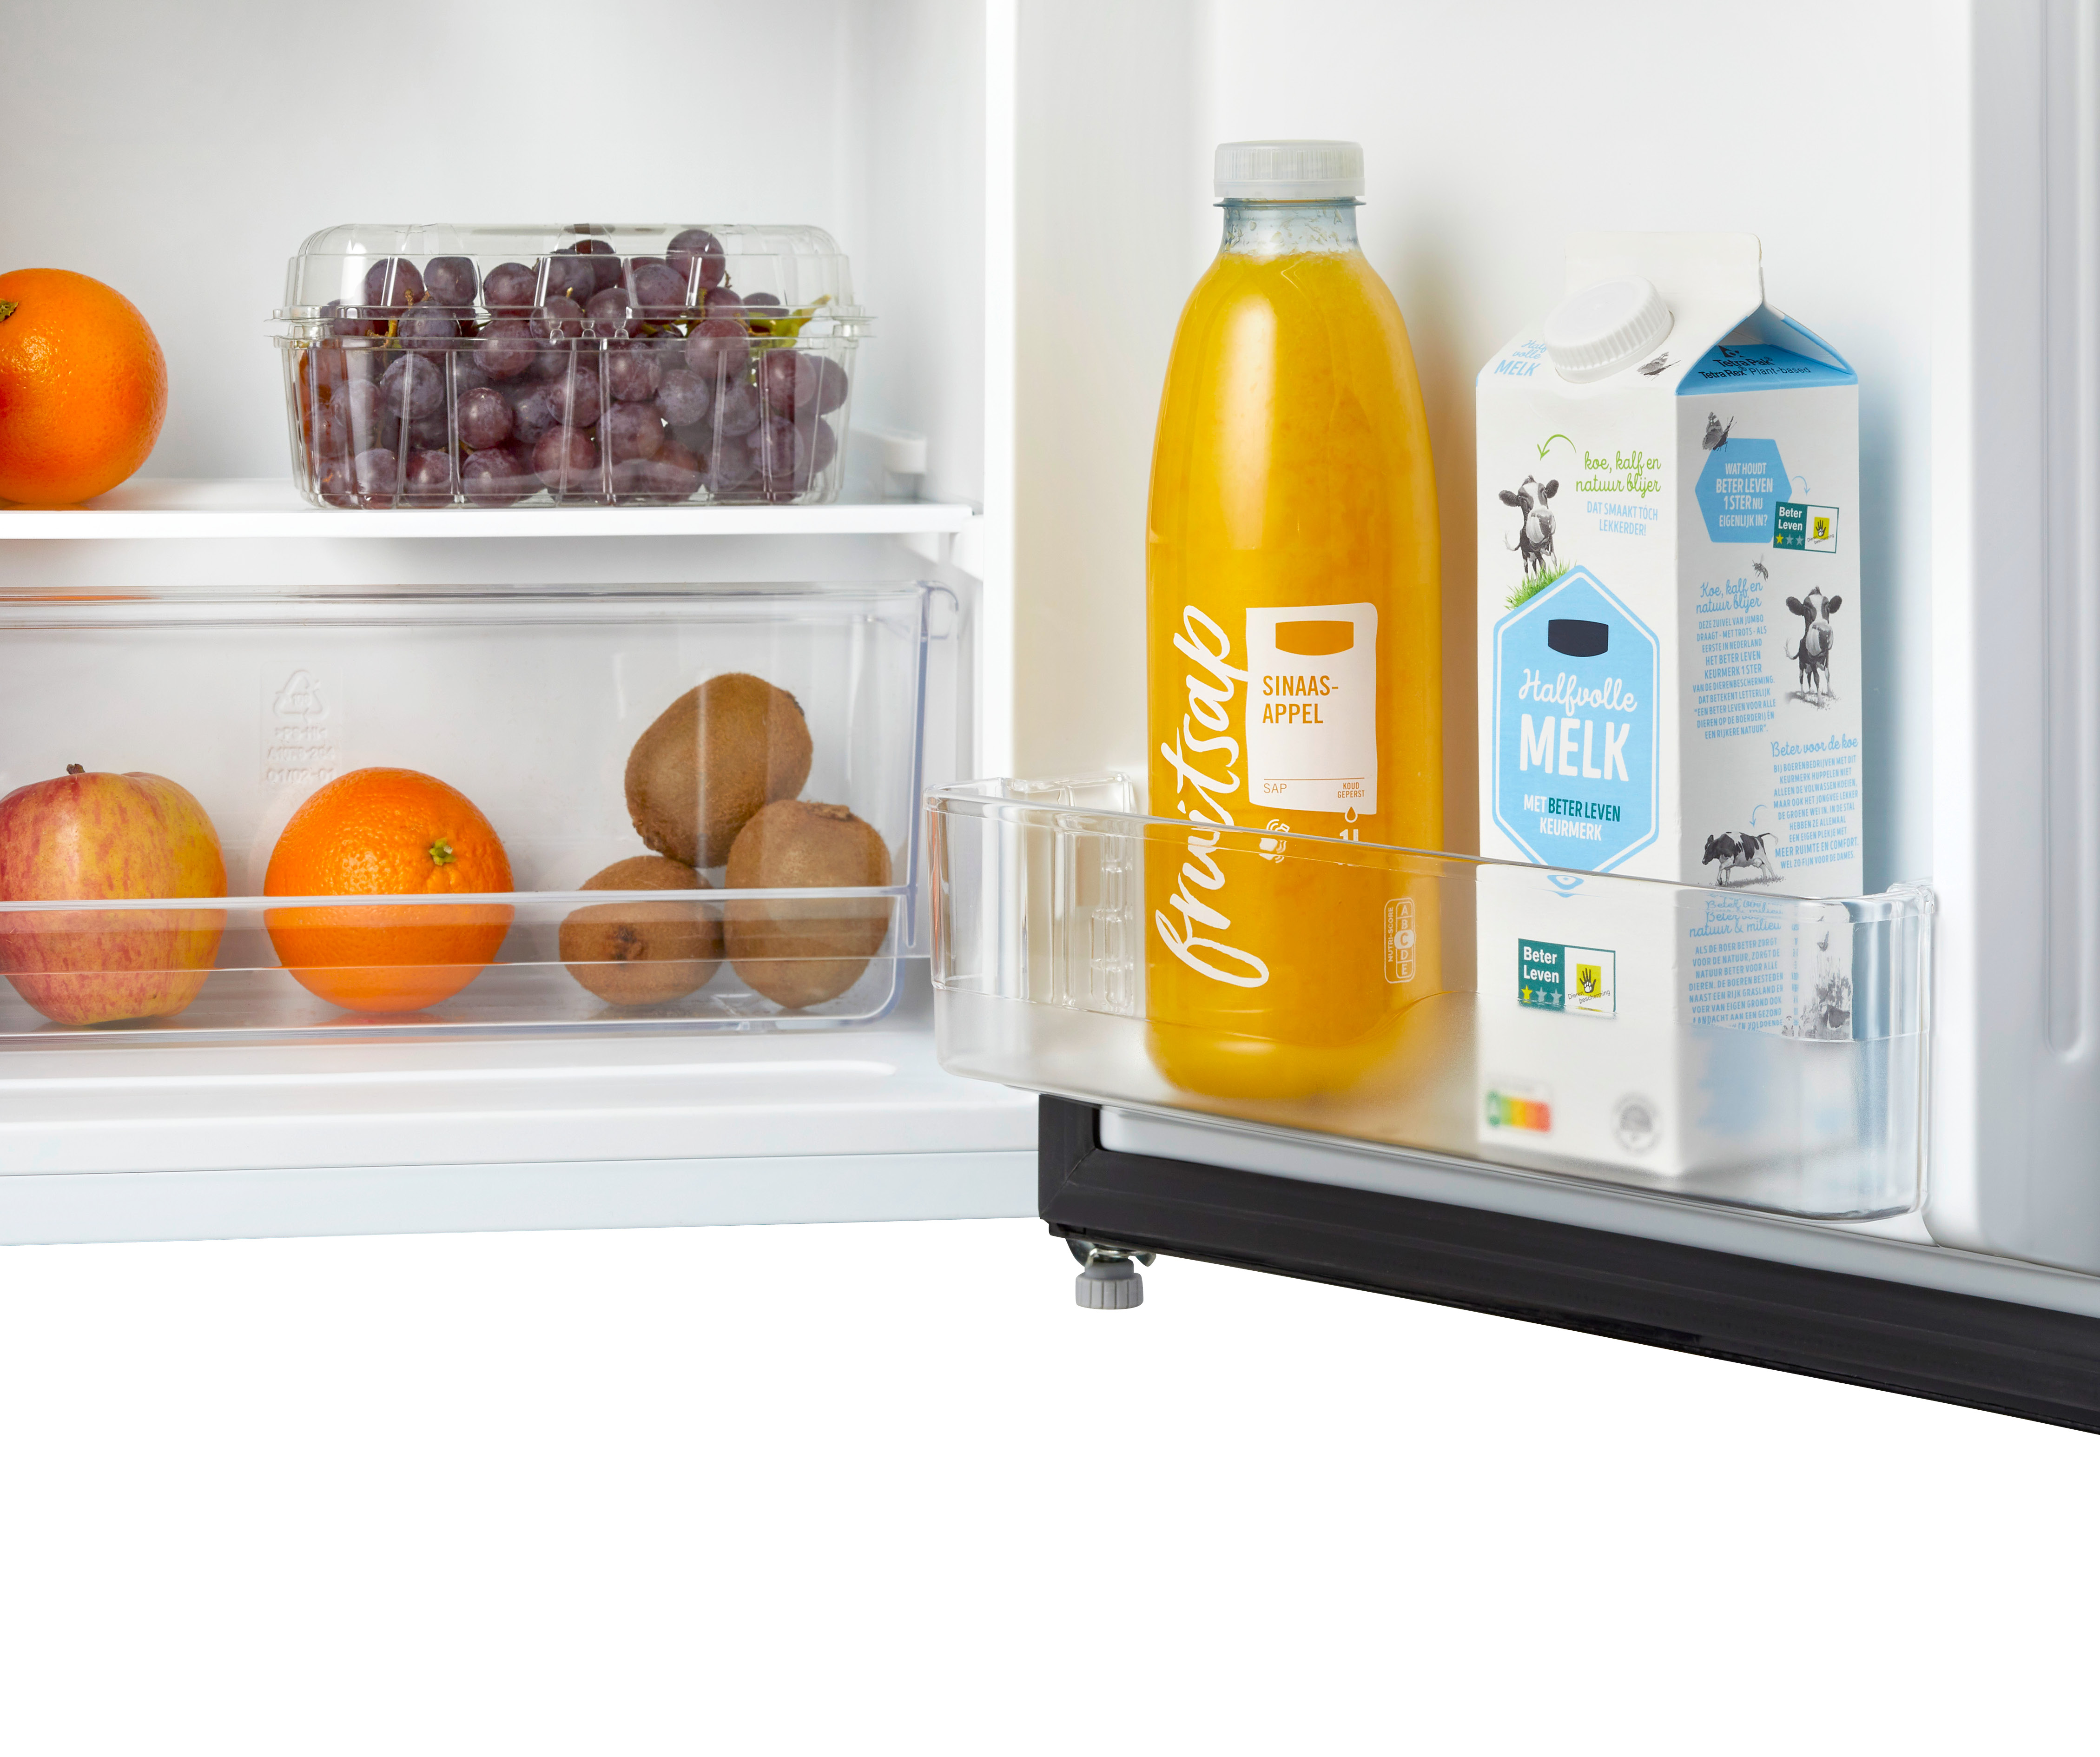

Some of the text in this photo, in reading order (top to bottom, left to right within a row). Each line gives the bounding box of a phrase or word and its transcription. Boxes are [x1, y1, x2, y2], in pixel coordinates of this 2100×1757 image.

[1512, 350, 1541, 359] volle
[1494, 360, 1541, 376] MELK
[1585, 451, 1661, 476] koe, kalf en
[1725, 463, 1766, 475] WAT HOUDT
[1576, 473, 1661, 498] natuur blijer
[1716, 478, 1773, 493] BETER LEVEN
[1724, 495, 1763, 509] 1 STER NU
[1587, 501, 1658, 521] DAT SMAAKT TÓCH
[1779, 507, 1802, 518] Beter
[1599, 519, 1646, 536] LEKKERDER!
[1719, 515, 1768, 528] EIGENLIJK IN?
[1778, 519, 1803, 531] Leven
[1700, 578, 1763, 598] Koe, kalf en
[1697, 594, 1762, 614] natuur blijer
[1699, 614, 1763, 629] DEZE ZUIVEL VAN JUMBO
[1697, 626, 1767, 641] DRAAGT MET TROTS ALS
[1702, 643, 1721, 653] EERSTE
[1730, 639, 1762, 649] NEDERLAND
[1706, 651, 1761, 666] HET BETER LEVEN
[1705, 664, 1762, 679] KEURMERK 1 STER
[1262, 675, 1339, 696] SINAAS-
[1519, 668, 1637, 716] Halfvolle
[1693, 676, 1775, 693] VAN DE DIERENBESCHERMING.
[1699, 688, 1770, 704] DAT BETEKENT LETTERLIJK
[1262, 703, 1323, 724] APPEL
[1710, 705, 1727, 714] BETER
[1728, 703, 1745, 712] LEVEN
[1746, 701, 1762, 710] VOOR
[1763, 699, 1776, 708] ALLE
[1697, 718, 1717, 728] DIEREN
[1719, 717, 1726, 726] OP
[1728, 716, 1734, 725] DE
[1736, 713, 1766, 723] BOERDERIJ
[1705, 731, 1715, 739] EEN
[1717, 727, 1739, 738] RIJKERE
[1519, 713, 1630, 782] MELK
[1771, 733, 1858, 757] Beter voor de koe
[1774, 765, 1782, 773] BIJ
[1784, 758, 1835, 772] BOERENBEDRIJVEN
[1836, 756, 1847, 765] MET
[1780, 767, 1851, 784] KEURMERK HUPPELEN NIET
[1264, 783, 1287, 793] SAP
[1774, 787, 1795, 797] ALLEEN
[1796, 786, 1803, 794] DE
[1804, 782, 1836, 793] VOLWASSEN
[1774, 790, 1858, 808] MAAR OOK HET JONGVEE LEKKER
[1524, 794, 1620, 822] MET BETER LEVEN
[1787, 809, 1808, 819] GROENE
[1810, 807, 1820, 816] WEI
[1844, 802, 1855, 811] STAL
[1540, 817, 1602, 841] KEURMERK
[1790, 816, 1846, 830] HEBBEN ZE ALLEMAAL
[1790, 827, 1847, 842] EEN EIGEN PLEKJE MET
[1775, 837, 1859, 858] MEER RUIMTE EN COMFORT.
[1781, 860, 1792, 869] WEL
[1794, 859, 1801, 867] ZO
[1802, 858, 1813, 866] FIJN
[1815, 855, 1829, 864] VOOR
[1837, 851, 1855, 860] DAMES.
[1401, 905, 1408, 916] A
[1401, 919, 1408, 929] B
[1690, 919, 1781, 938] natuur & milieu
[1400, 932, 1408, 946] C
[1695, 945, 1707, 954] ALS
[1719, 943, 1735, 951] BOER
[1737, 940, 1756, 950] BETER
[1758, 938, 1777, 946] ZORGT
[1401, 950, 1408, 960] D
[1524, 946, 1557, 964] Beter
[1693, 958, 1711, 967] VOOR
[1713, 956, 1721, 965] DE
[1723, 953, 1750, 964] NATUUR,
[1752, 949, 1771, 959] ZORGT
[1401, 964, 1407, 975] E
[1524, 965, 1559, 983] Leven
[1579, 990, 1610, 1004] bescherming
